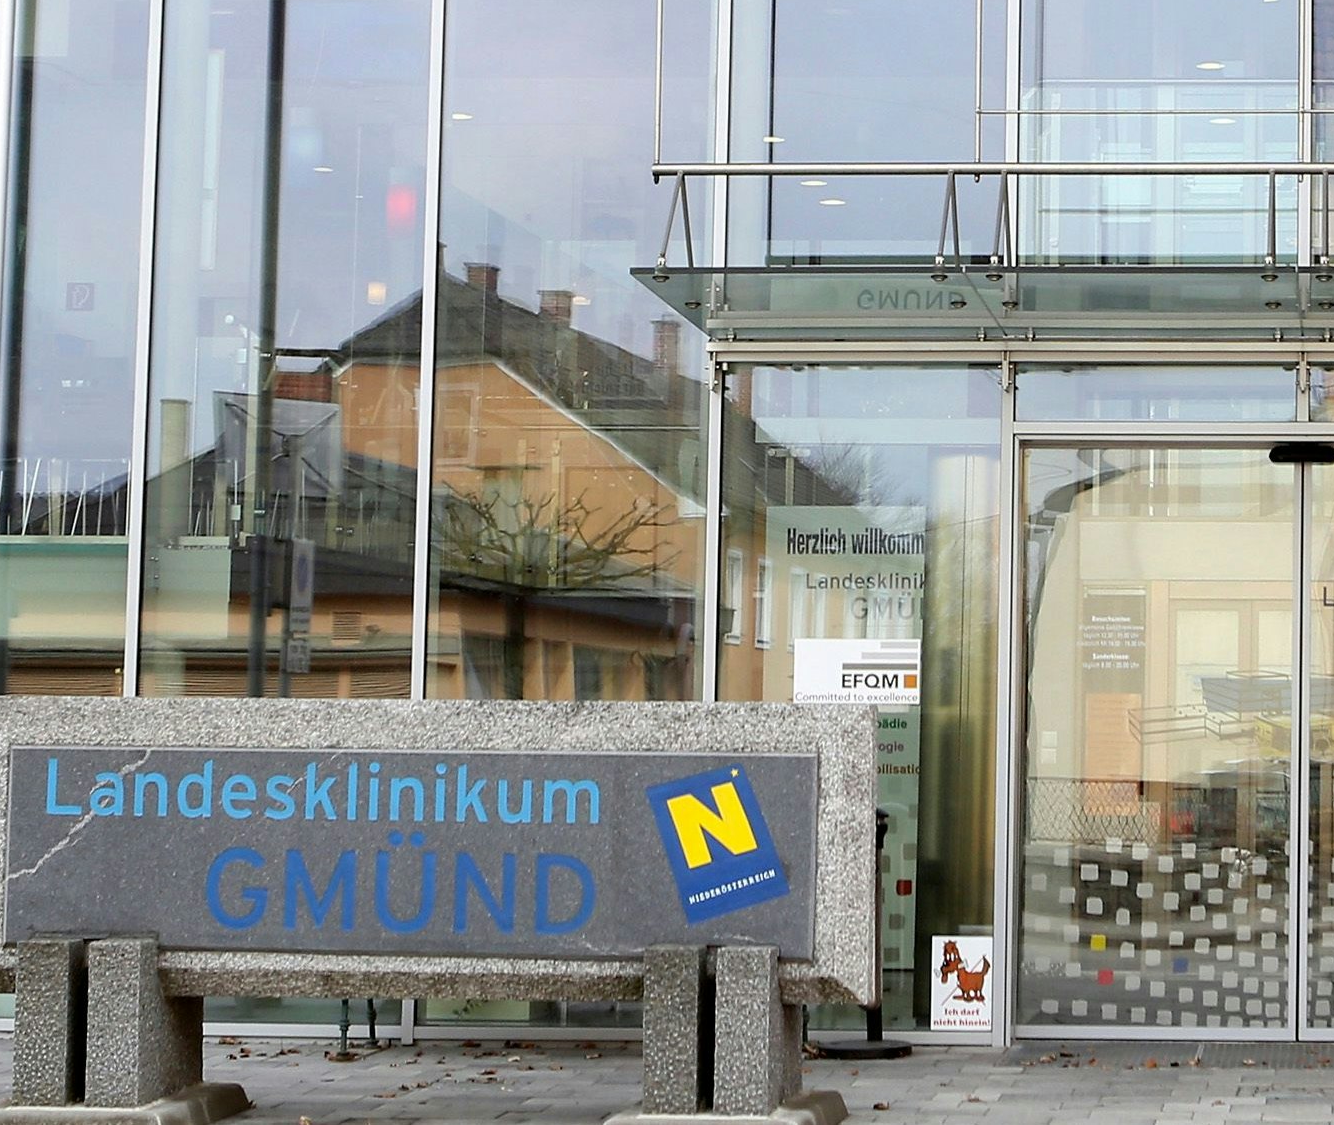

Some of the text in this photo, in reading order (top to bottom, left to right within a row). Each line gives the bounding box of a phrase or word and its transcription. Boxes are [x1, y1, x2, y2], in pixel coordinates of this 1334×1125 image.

[787, 528, 846, 554] Herzlich
[852, 592, 925, 619] GMÜ
[842, 674, 899, 689] EFQM
[795, 692, 918, 702] Committed to excellence
[45, 757, 758, 869] Landesklinikum N
[205, 830, 597, 936] GMÜND
[688, 869, 776, 905] NIEDERÖSTERREICH
[933, 1018, 990, 1026] nicht hinein!
[944, 1008, 980, 1016] Ich darf
